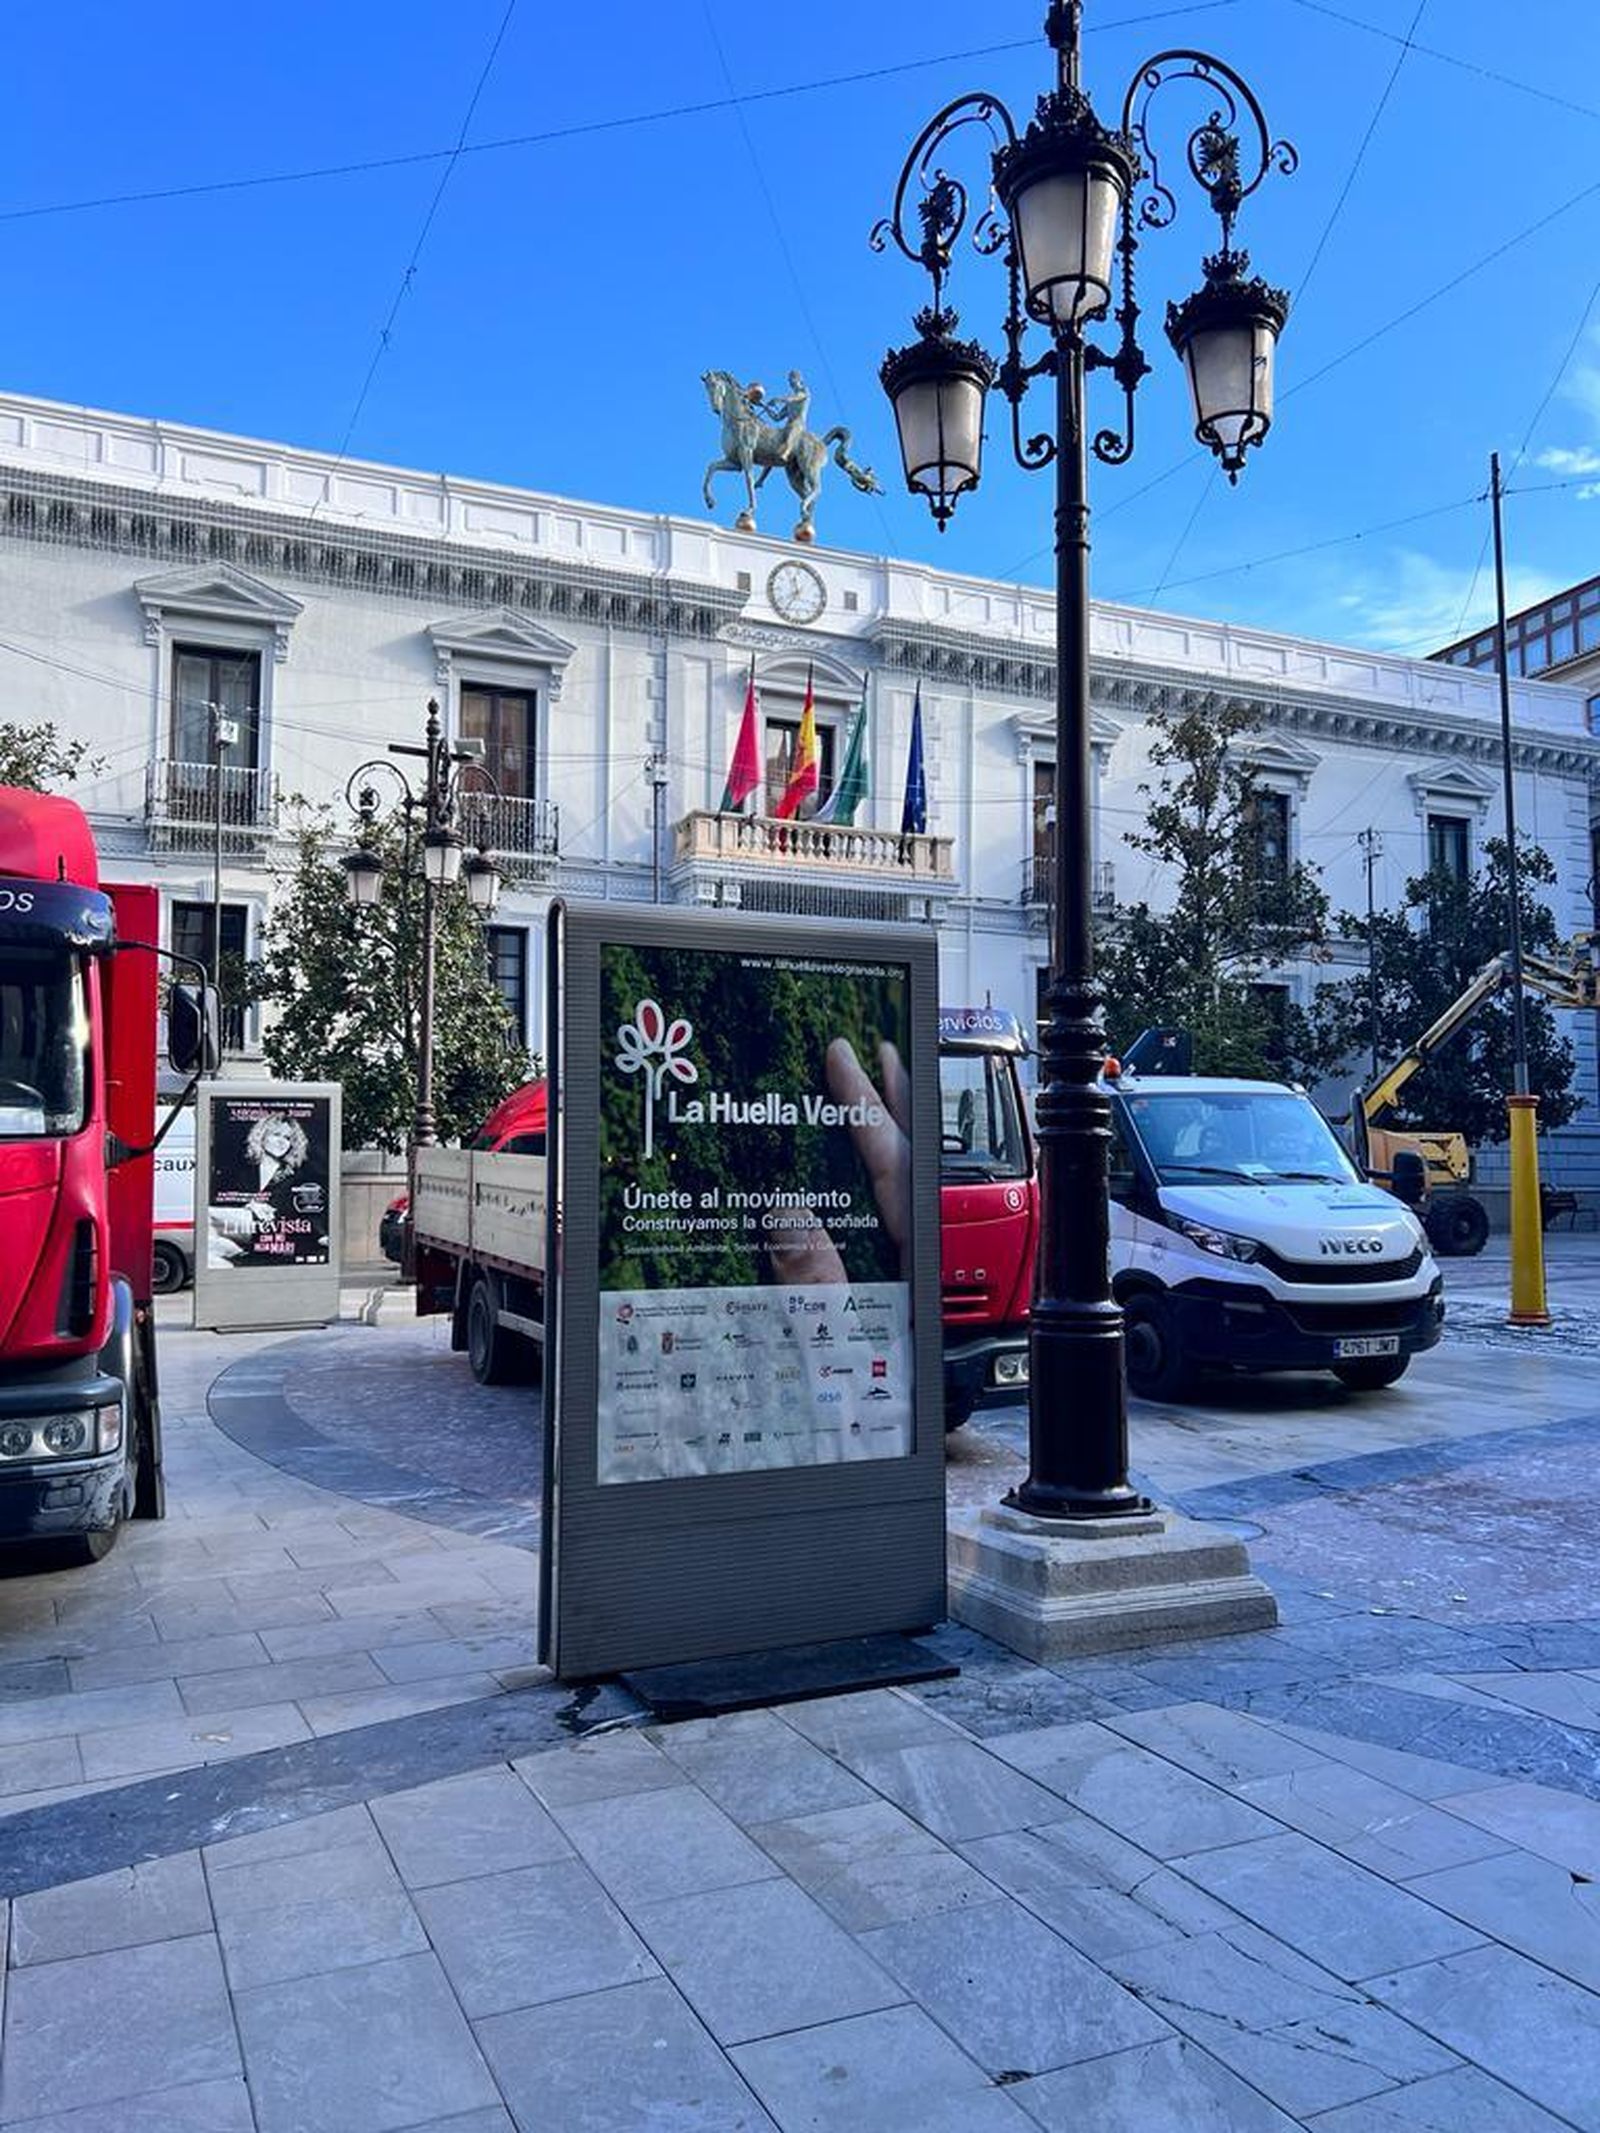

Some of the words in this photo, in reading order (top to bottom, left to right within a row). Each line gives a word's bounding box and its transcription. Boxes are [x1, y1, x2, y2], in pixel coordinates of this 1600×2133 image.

[668, 1091, 704, 1123] La
[710, 1092, 799, 1125] Huella
[802, 1095, 885, 1126] Verde
[623, 1182, 692, 1209] Únete
[700, 1187, 719, 1209] al
[727, 1187, 851, 1209] movimiento
[1009, 1190, 1020, 1207] 8
[622, 1213, 738, 1234] Construyamos
[743, 1214, 756, 1230] la
[761, 1214, 823, 1230] Granada
[827, 1213, 879, 1229] soñada
[1319, 1239, 1383, 1255] IVECO
